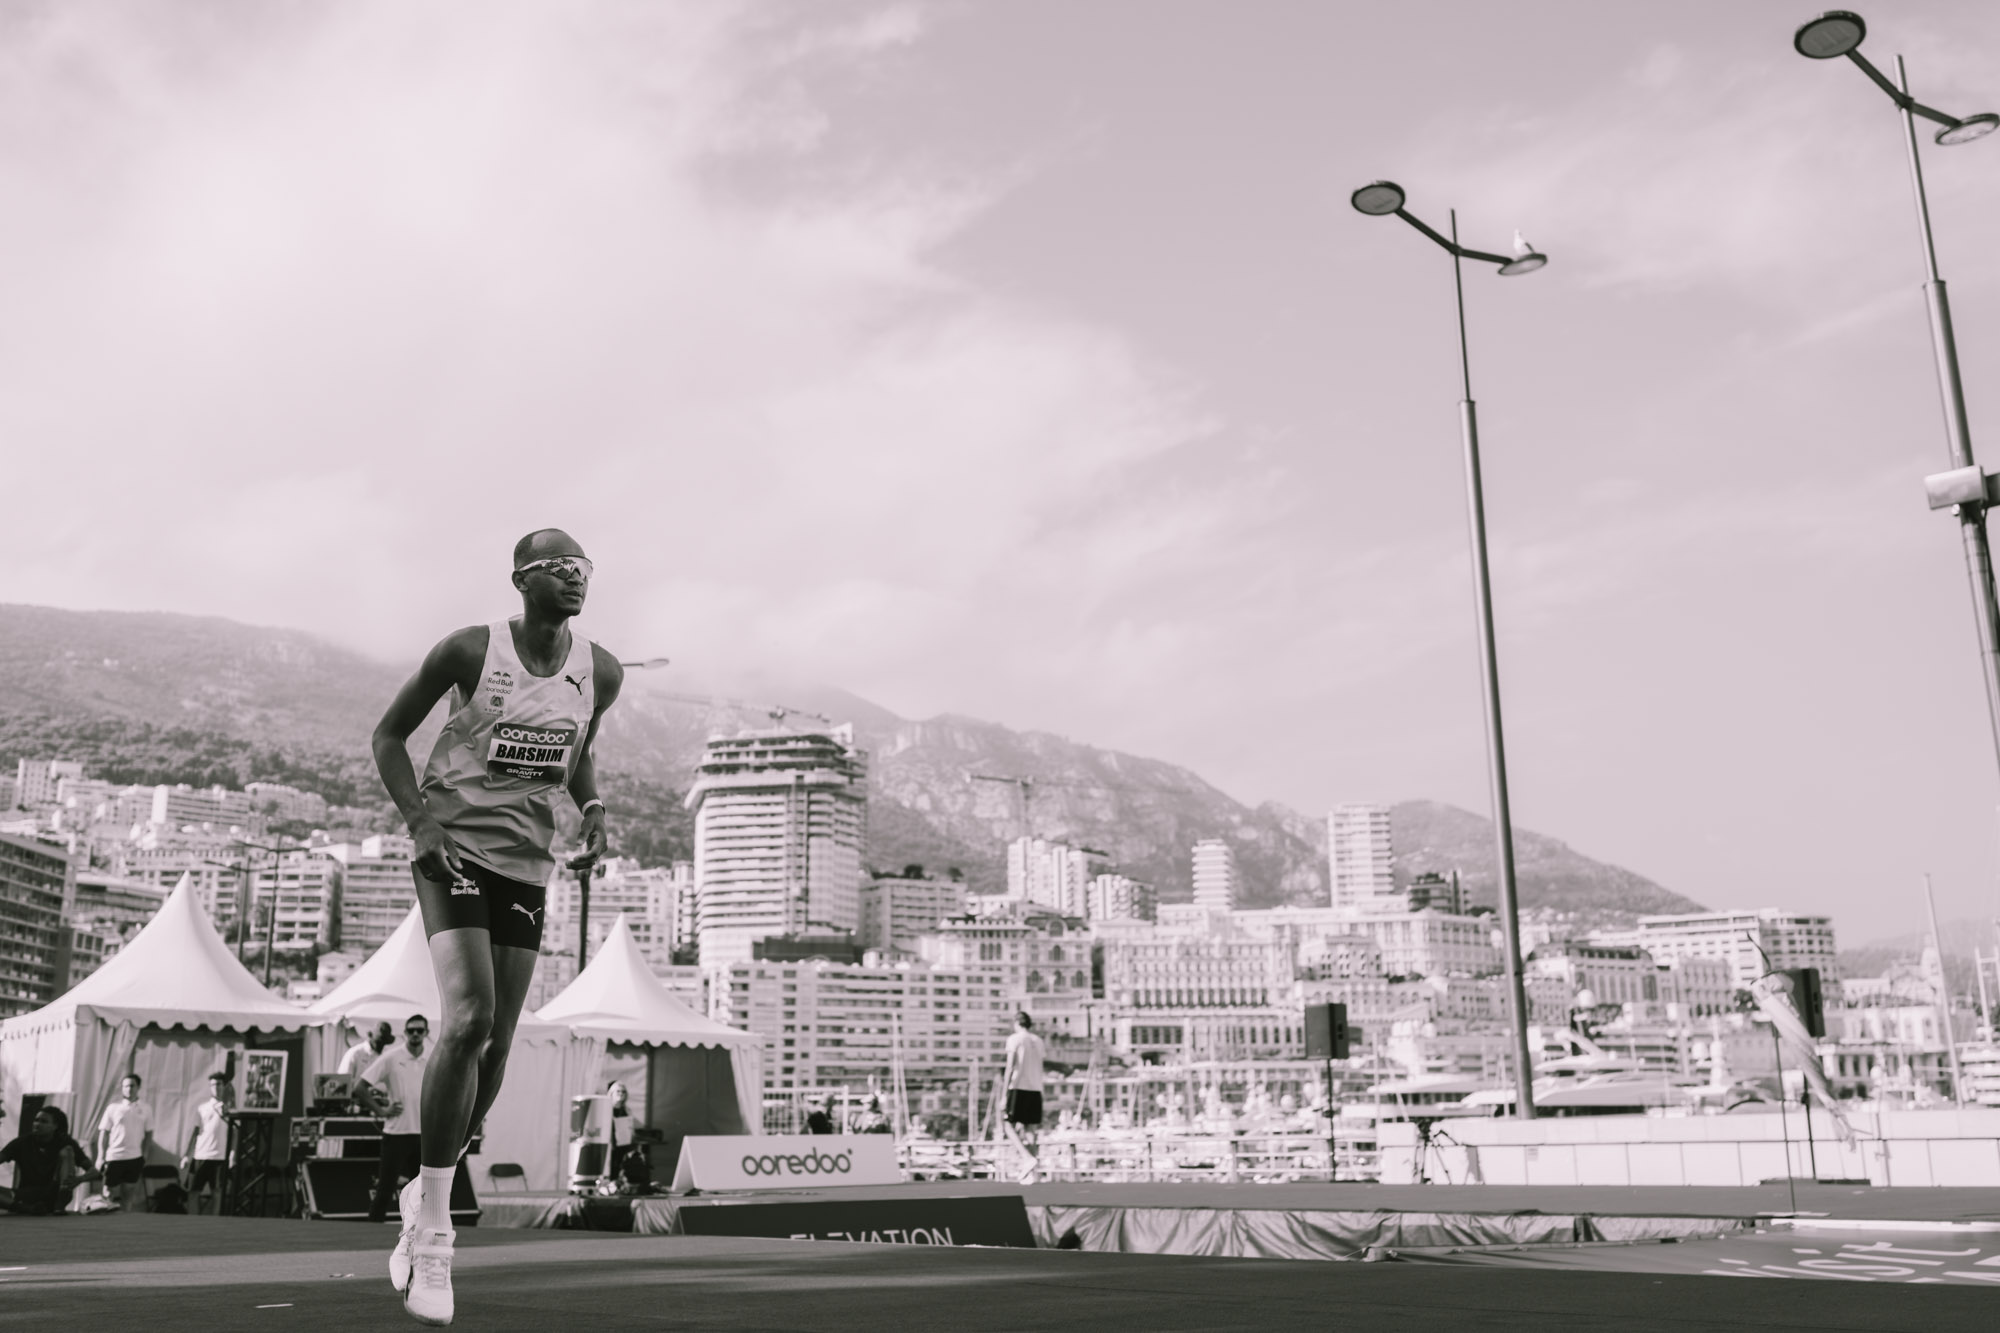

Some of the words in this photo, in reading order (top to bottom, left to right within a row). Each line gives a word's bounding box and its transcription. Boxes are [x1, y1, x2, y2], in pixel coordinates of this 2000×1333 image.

[487, 677, 501, 685] Red
[501, 679, 514, 687] Bull
[500, 727, 567, 744] ooredoo
[495, 743, 565, 762] BARSHIM
[506, 768, 544, 777] GRAVITY
[741, 1147, 852, 1176] ooredoo
[789, 1226, 954, 1247] VATION
